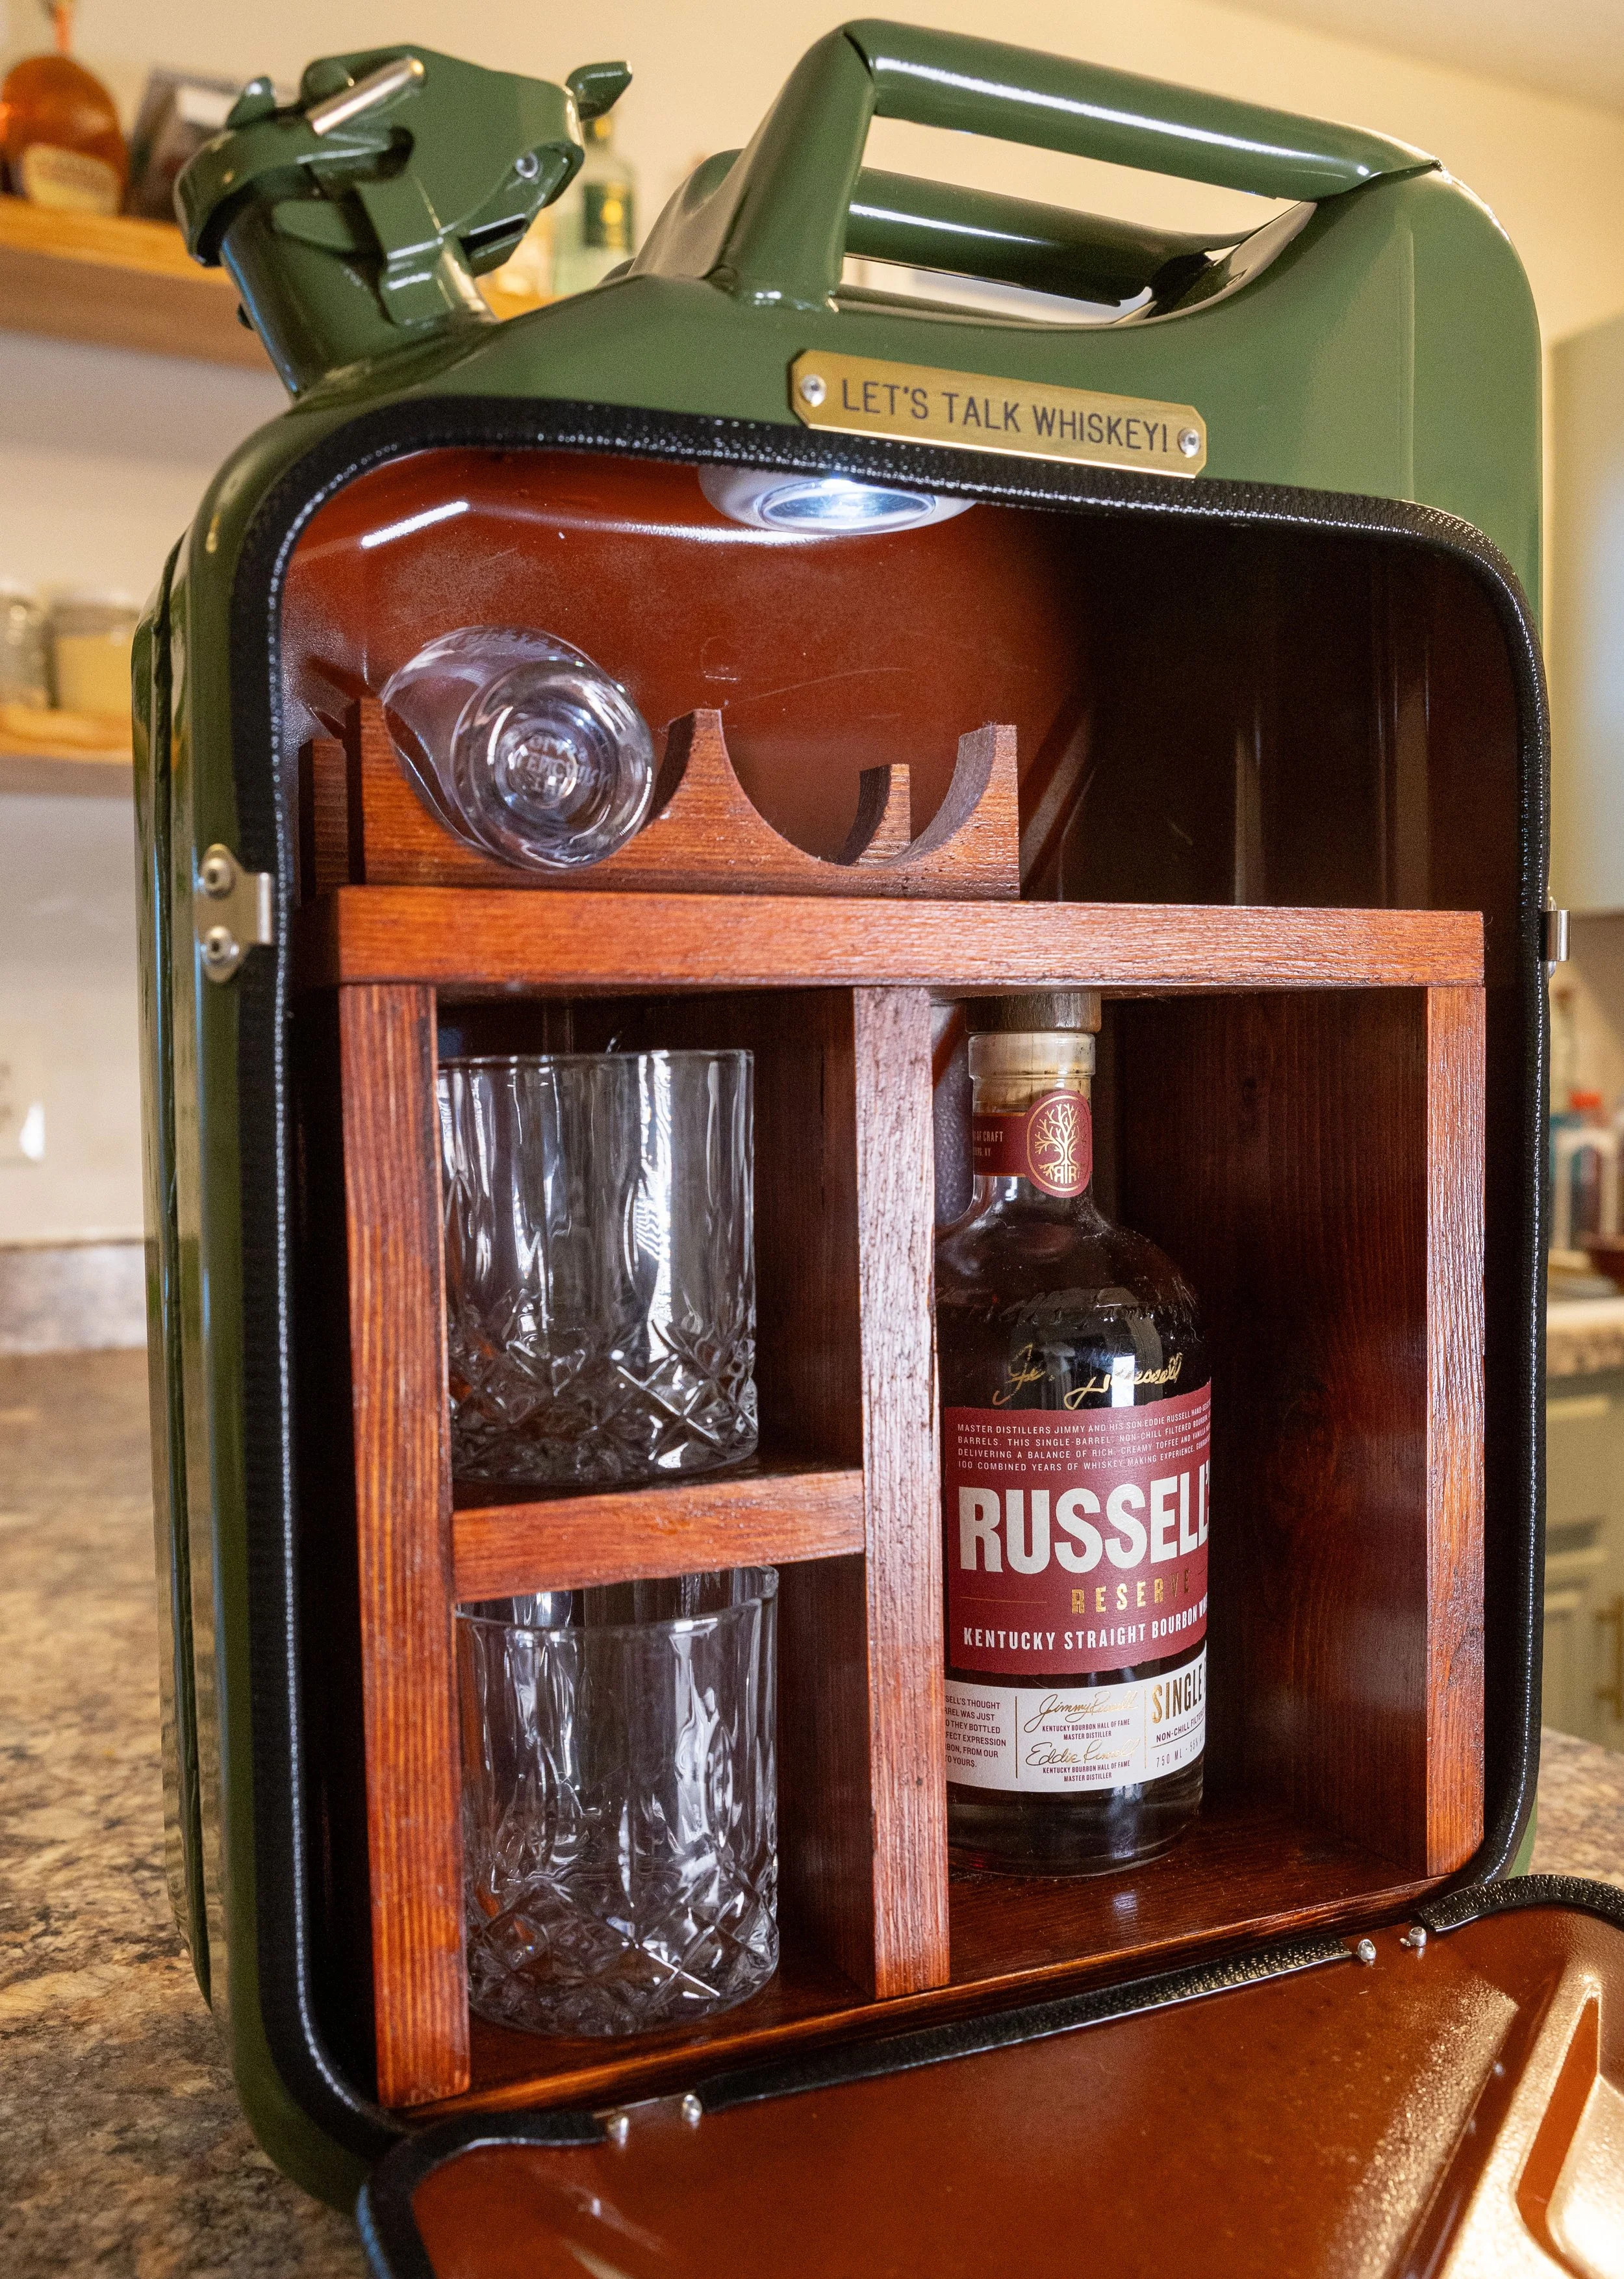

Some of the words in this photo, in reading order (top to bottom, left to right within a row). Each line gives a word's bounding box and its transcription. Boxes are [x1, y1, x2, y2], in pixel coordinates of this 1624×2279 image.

[842, 378, 928, 419] LET'S
[942, 392, 1020, 432] TALK
[983, 1130, 1004, 1142] CRAFT
[958, 1423, 993, 1433] MASTER
[996, 1425, 1050, 1434] DISTILLERS
[1054, 1425, 1084, 1434] JIMMY
[1088, 1424, 1106, 1433] AND
[1109, 1422, 1123, 1431] HIS
[1126, 1420, 1142, 1429] SON
[1144, 1416, 1165, 1427] EDDIE
[1167, 1410, 1190, 1423] RUSSELL
[958, 1436, 1002, 1446] BARRELS.
[1008, 1438, 1030, 1447] THIS
[1119, 1429, 1161, 1442] NON-CHILL
[1165, 1422, 1191, 1435] FILTERED
[958, 1448, 1012, 1458] DELIVERING
[1028, 1450, 1071, 1459] BALANCE
[1076, 1449, 1087, 1458] OF
[1121, 1444, 1152, 1455] CREAMY
[1156, 1438, 1178, 1449] TOFFEE
[1180, 1434, 1191, 1444] AND
[958, 1460, 972, 1469] 100
[978, 1461, 1026, 1471] COMBINED
[1032, 1463, 1061, 1471] YEARS
[1067, 1462, 1078, 1471] OF
[1084, 1460, 1124, 1470] WHISKEY
[1128, 1455, 1156, 1466] MAKING
[1160, 1445, 1195, 1461] EXPERIENCE.
[958, 1459, 1210, 1575] RUSSELL'
[1071, 1568, 1190, 1614] RESERVE
[963, 1627, 1056, 1651] KENTUCKY
[1064, 1623, 1145, 1651] STRAIGHT
[1151, 1603, 1197, 1640] BOURBON
[945, 1695, 966, 1706] SELL'S
[967, 1698, 1000, 1710] THOUGHT
[1151, 1664, 1202, 1724] SINGLE
[945, 1707, 959, 1717] RREL
[960, 1709, 975, 1720] WAS
[976, 1712, 995, 1721] JUST
[950, 1720, 968, 1730] THEY
[969, 1723, 1000, 1734] BOTTLED
[1042, 1724, 1071, 1733] KENTUCKY
[1071, 1723, 1096, 1731] BOURBON
[1097, 1722, 1110, 1730] HALL
[1117, 1718, 1130, 1727] FAME
[1063, 1732, 1085, 1740] MASTER
[1085, 1730, 1112, 1739] DISTILLER
[1156, 1722, 1190, 1743] NON-CHILL
[946, 1731, 961, 1740] FECT
[963, 1734, 1006, 1747] EXPRESSION
[945, 1743, 962, 1754] BON,
[963, 1746, 982, 1757] FROM
[983, 1749, 998, 1758] OUR
[1025, 1742, 1081, 1766] Eddie
[1156, 1753, 1170, 1768] 750
[1174, 1748, 1182, 1761] ML
[953, 1756, 977, 1768] YOURS.
[1072, 1764, 1097, 1773] BOURBON
[1097, 1763, 1110, 1772] HALL
[1117, 1760, 1130, 1768] FAME
[1063, 1774, 1085, 1782] MASTER
[1086, 1772, 1112, 1781] DISTILLER
